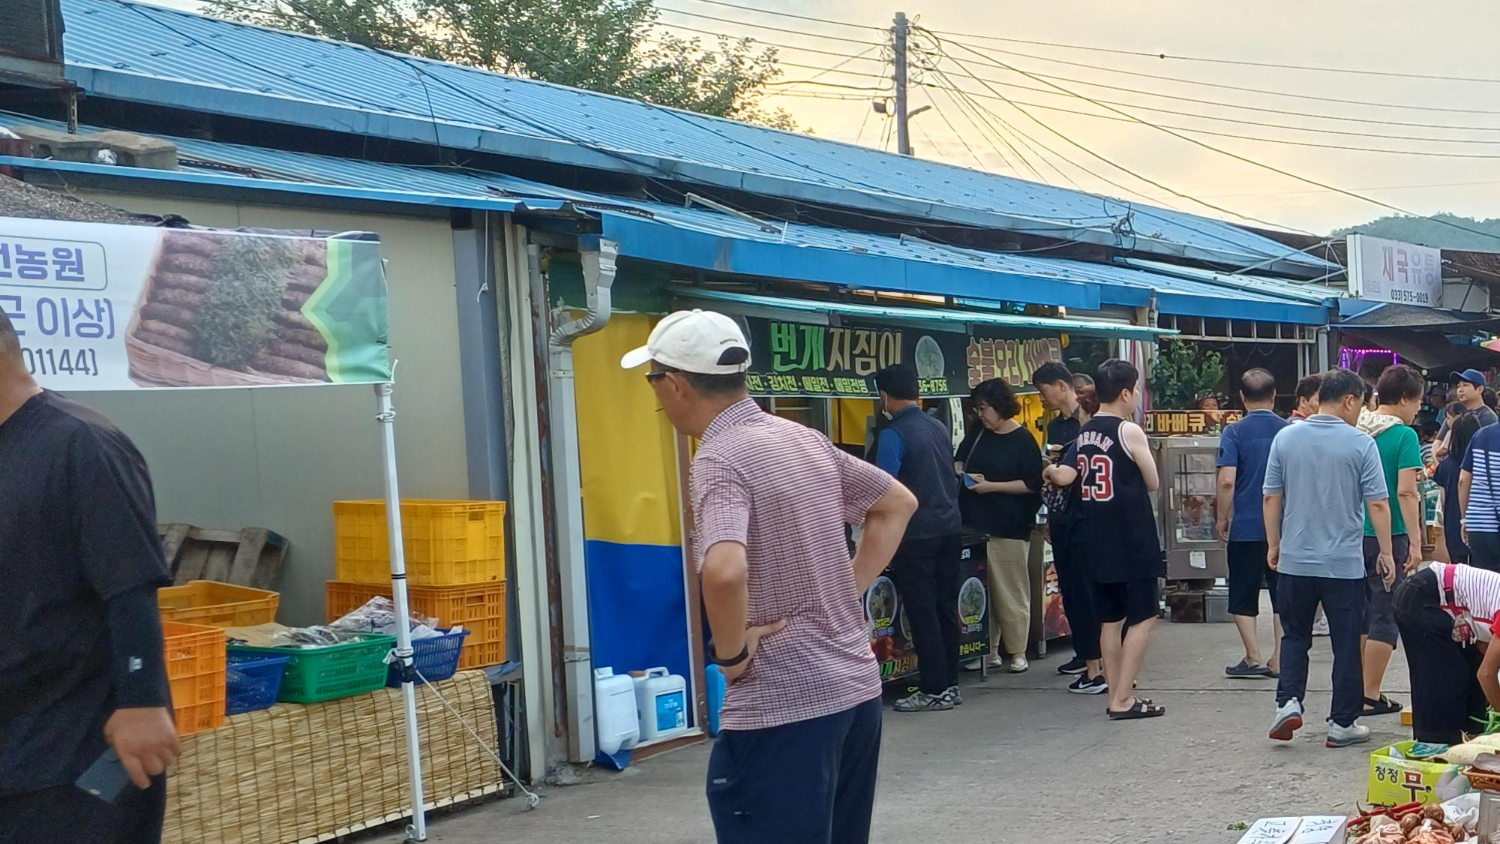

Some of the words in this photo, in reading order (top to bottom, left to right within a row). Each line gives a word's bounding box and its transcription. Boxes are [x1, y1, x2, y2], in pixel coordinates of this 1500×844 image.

[1157, 413, 1206, 433] 바베큐
[1076, 431, 1114, 452] ORDAN
[1077, 454, 1114, 501] 23
[1375, 765, 1398, 784] 청정
[1401, 771, 1427, 802] 무
